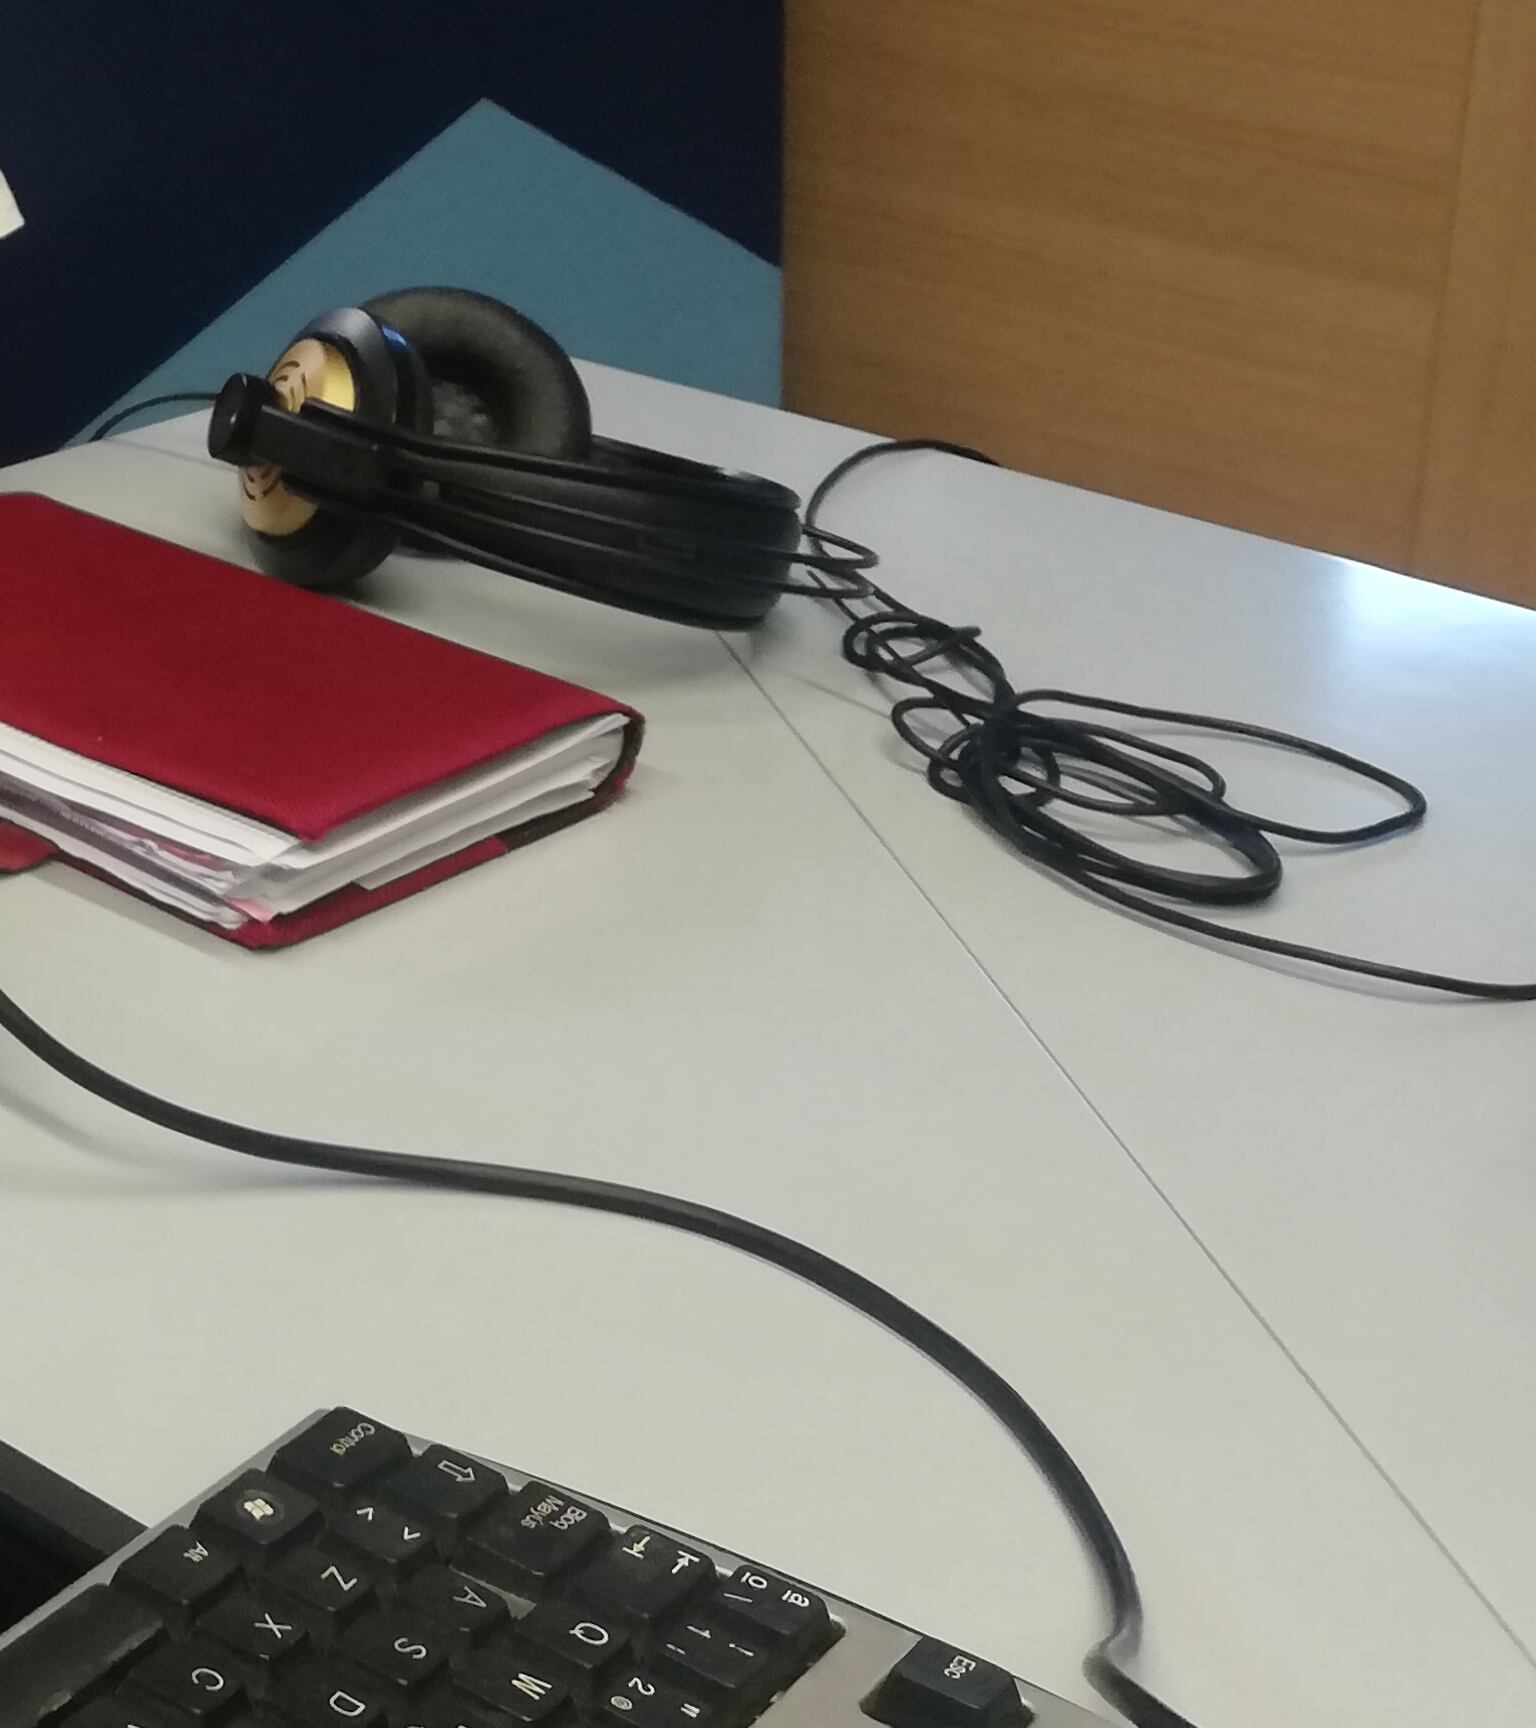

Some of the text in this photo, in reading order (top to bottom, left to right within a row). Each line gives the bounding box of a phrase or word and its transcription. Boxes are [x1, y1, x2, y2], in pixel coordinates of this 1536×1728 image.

[320, 1566, 357, 1592] Z
[452, 1586, 488, 1609] A
[254, 1613, 292, 1639] X
[568, 1622, 610, 1646] Q
[393, 1637, 427, 1660] S
[192, 1668, 224, 1691] C
[944, 1655, 977, 1680] Esc
[511, 1673, 552, 1700] W
[628, 1678, 655, 1696] 2
[329, 1690, 366, 1717] D
